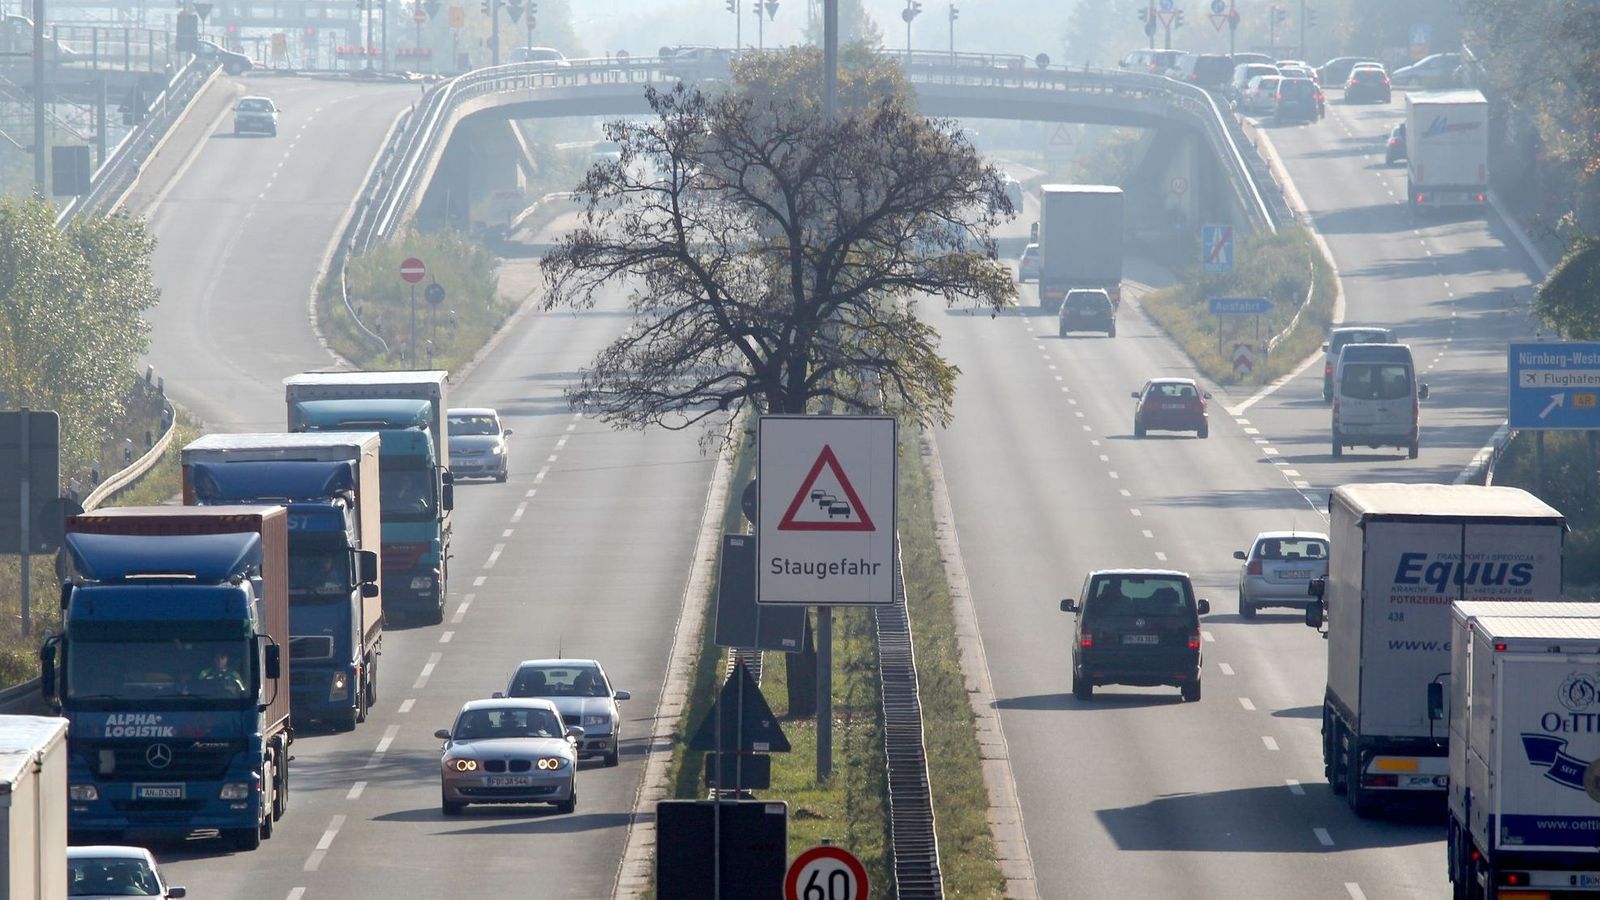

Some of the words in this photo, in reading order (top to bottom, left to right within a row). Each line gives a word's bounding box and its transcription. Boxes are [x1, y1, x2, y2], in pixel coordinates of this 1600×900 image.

[771, 557, 881, 579] Staugefahr
[1394, 552, 1534, 593] Equus
[106, 714, 158, 726] ALPHA
[104, 726, 174, 737] LOGISTIK
[803, 869, 850, 900] 60
